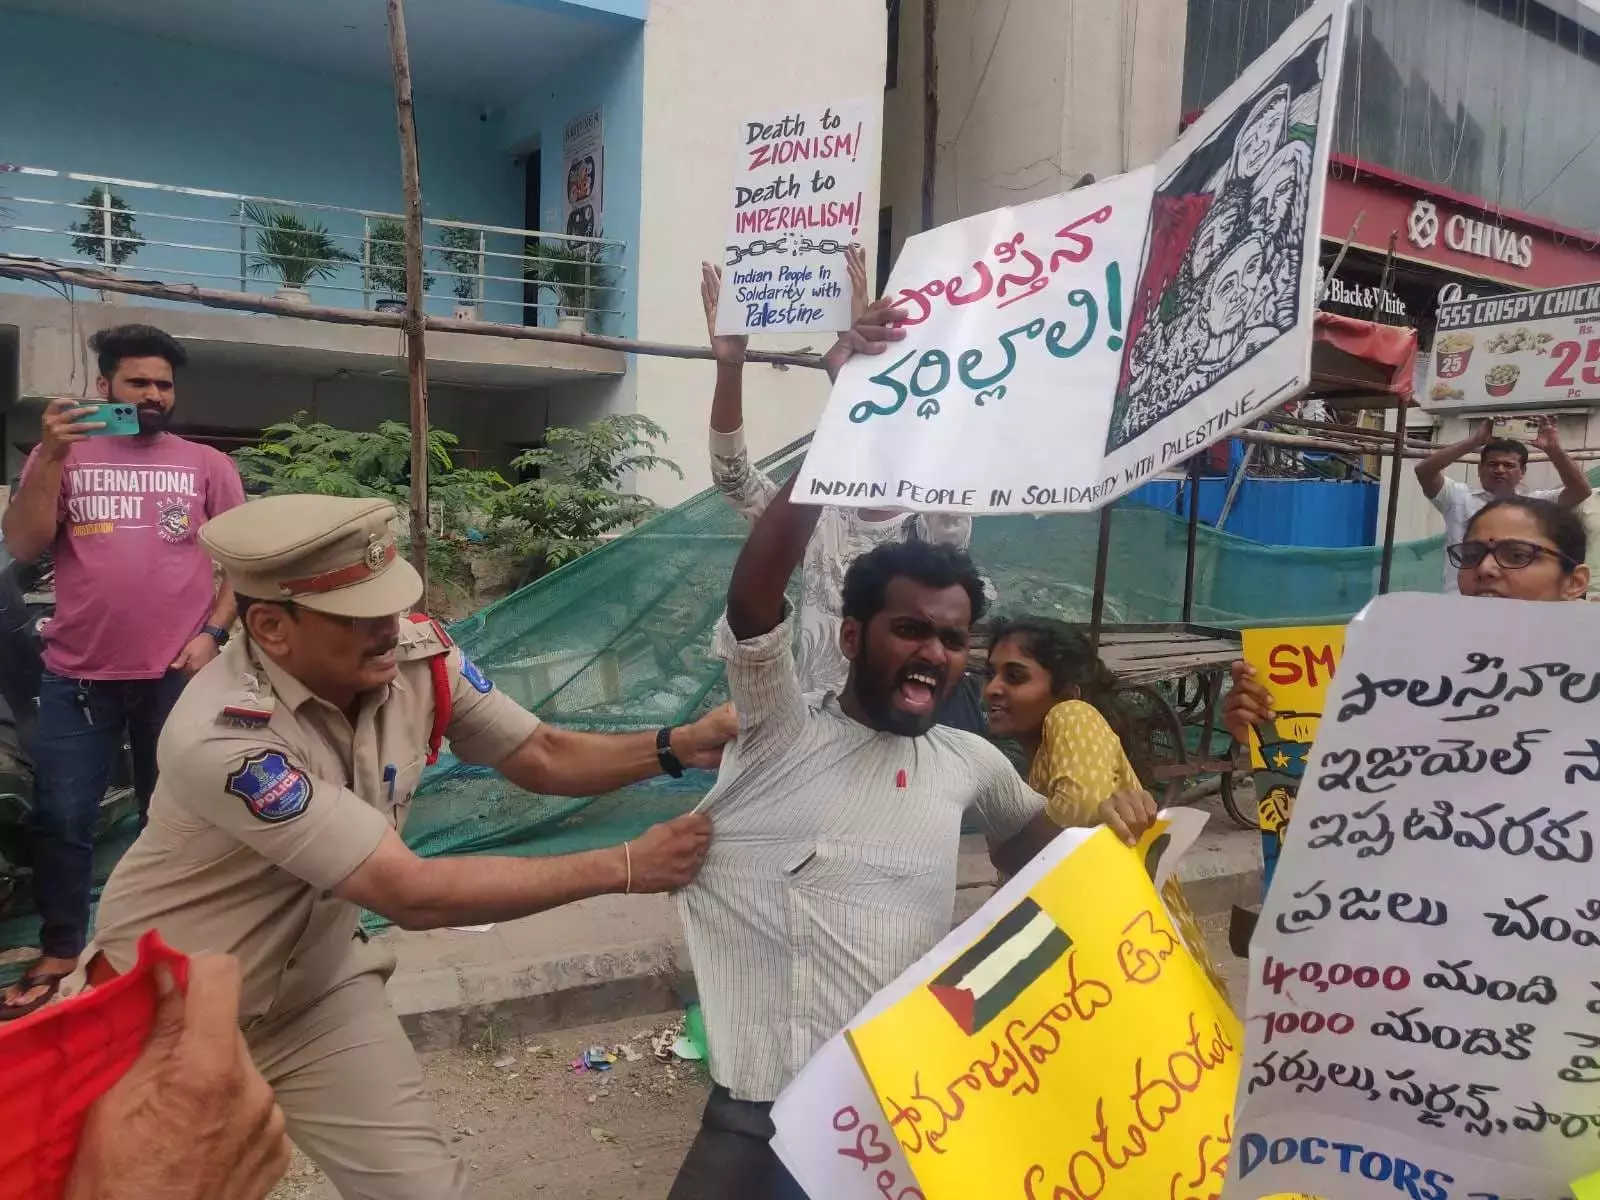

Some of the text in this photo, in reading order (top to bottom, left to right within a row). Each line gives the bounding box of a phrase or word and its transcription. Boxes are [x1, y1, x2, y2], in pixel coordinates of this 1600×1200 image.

[746, 108, 840, 145] Death to
[748, 121, 861, 170] ZIONISM!
[735, 170, 835, 208] Death to
[736, 191, 862, 235] IMPERIALISM!
[1445, 214, 1533, 268] CHIVAS
[733, 268, 772, 285] Indian
[778, 265, 812, 284] People
[736, 282, 841, 302] Solidarity with
[746, 302, 824, 327] Palestine
[1474, 293, 1543, 324] CRISPY
[1440, 356, 1462, 373] 25
[810, 389, 1256, 506] INDIAN PEOPLE IN SOLIDARITY WITH PALESTINE
[69, 469, 197, 496] INTERNATIONAL
[69, 496, 144, 522] STUDENT
[1268, 643, 1344, 688] SM
[256, 773, 299, 808] POLICE
[1262, 956, 1411, 994] 40,000
[1239, 1132, 1454, 1200] DOCTORS
